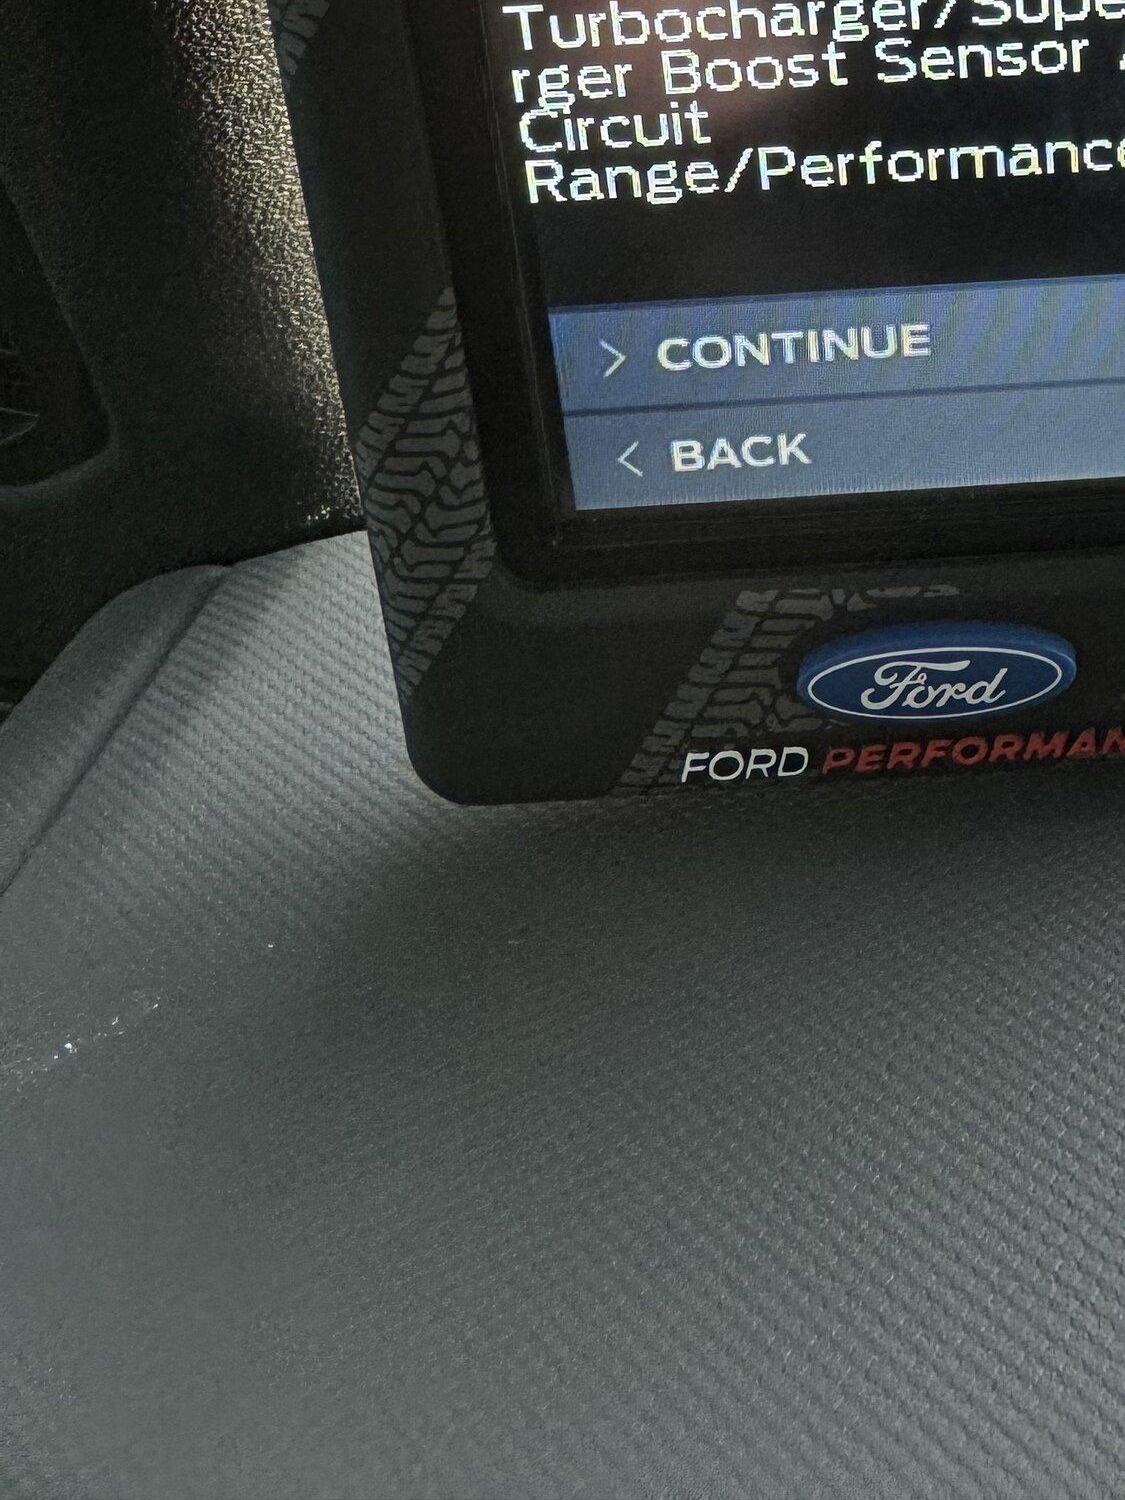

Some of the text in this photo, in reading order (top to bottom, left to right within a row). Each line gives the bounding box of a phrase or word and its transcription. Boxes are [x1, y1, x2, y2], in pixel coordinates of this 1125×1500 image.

[511, 58, 634, 116] rger
[663, 40, 849, 97] Boost
[875, 33, 1091, 85] Sensor
[519, 99, 710, 154] Circuit
[657, 322, 932, 373] CONTINUE
[670, 433, 811, 473] BACK
[861, 659, 1007, 712] Ford
[680, 745, 809, 785] FORD
